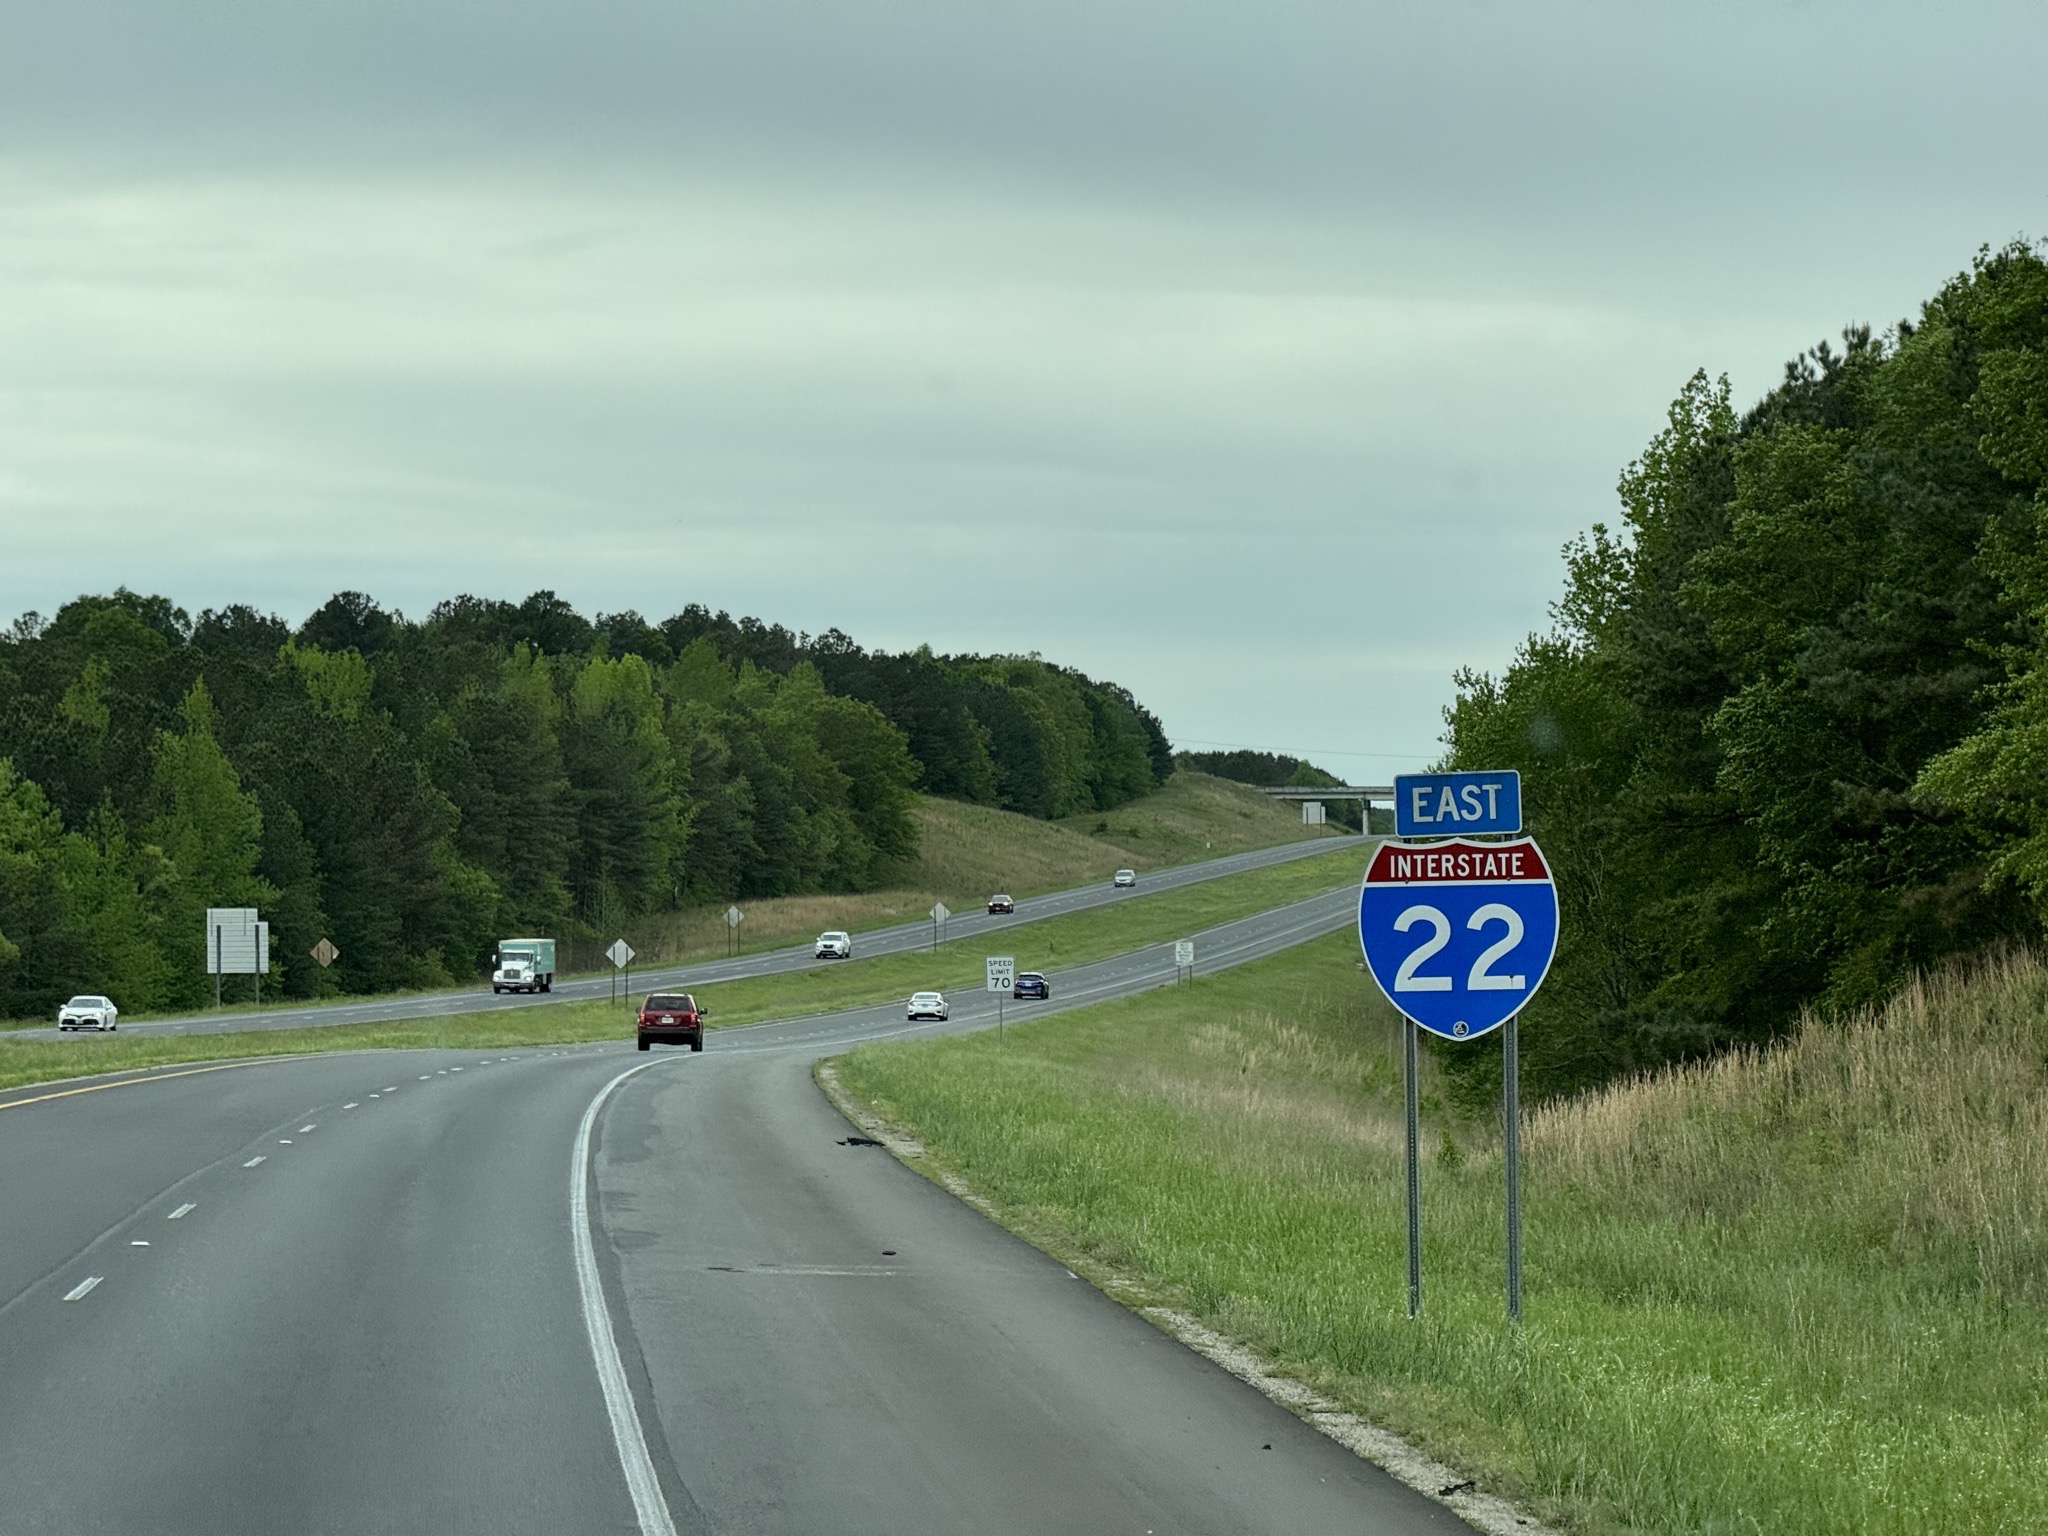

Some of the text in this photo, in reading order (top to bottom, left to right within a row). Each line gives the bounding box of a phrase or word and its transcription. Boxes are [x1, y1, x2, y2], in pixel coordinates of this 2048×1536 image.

[1412, 784, 1502, 823] EAST
[1390, 853, 1524, 878] INTERSTATE
[1393, 903, 1526, 992] 22
[991, 977, 1011, 988] 70
